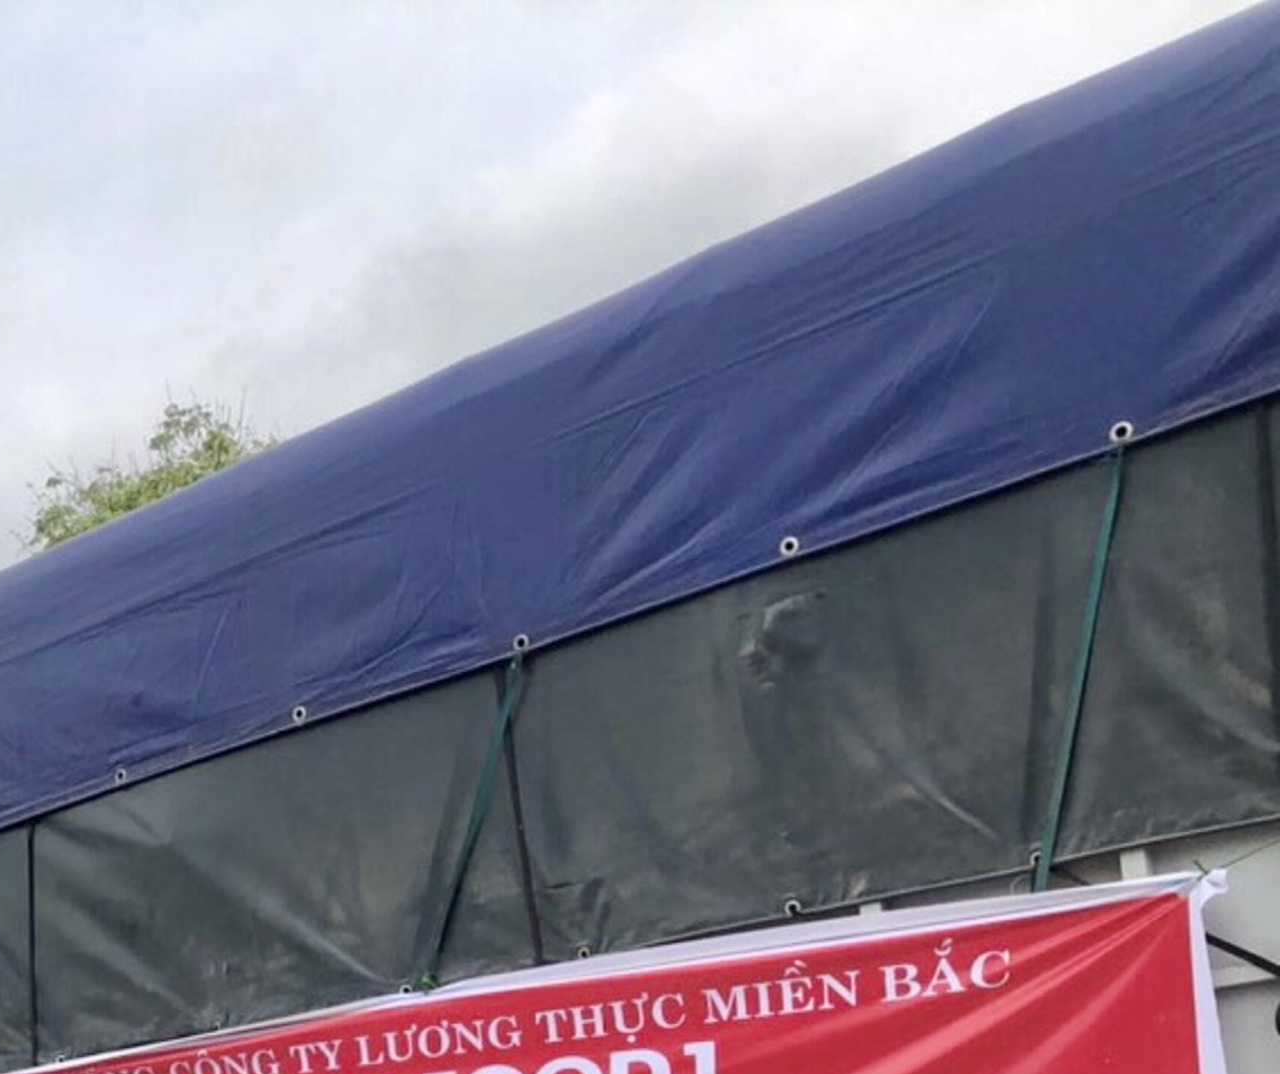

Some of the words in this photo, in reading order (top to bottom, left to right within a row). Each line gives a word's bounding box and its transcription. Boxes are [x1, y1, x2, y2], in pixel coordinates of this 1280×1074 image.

[289, 1038, 343, 1074] TY
[354, 1014, 523, 1067] LƯƠNG
[534, 992, 687, 1044] THỰC
[702, 959, 861, 1025] MIỀN
[879, 938, 1012, 1003] BẮC
